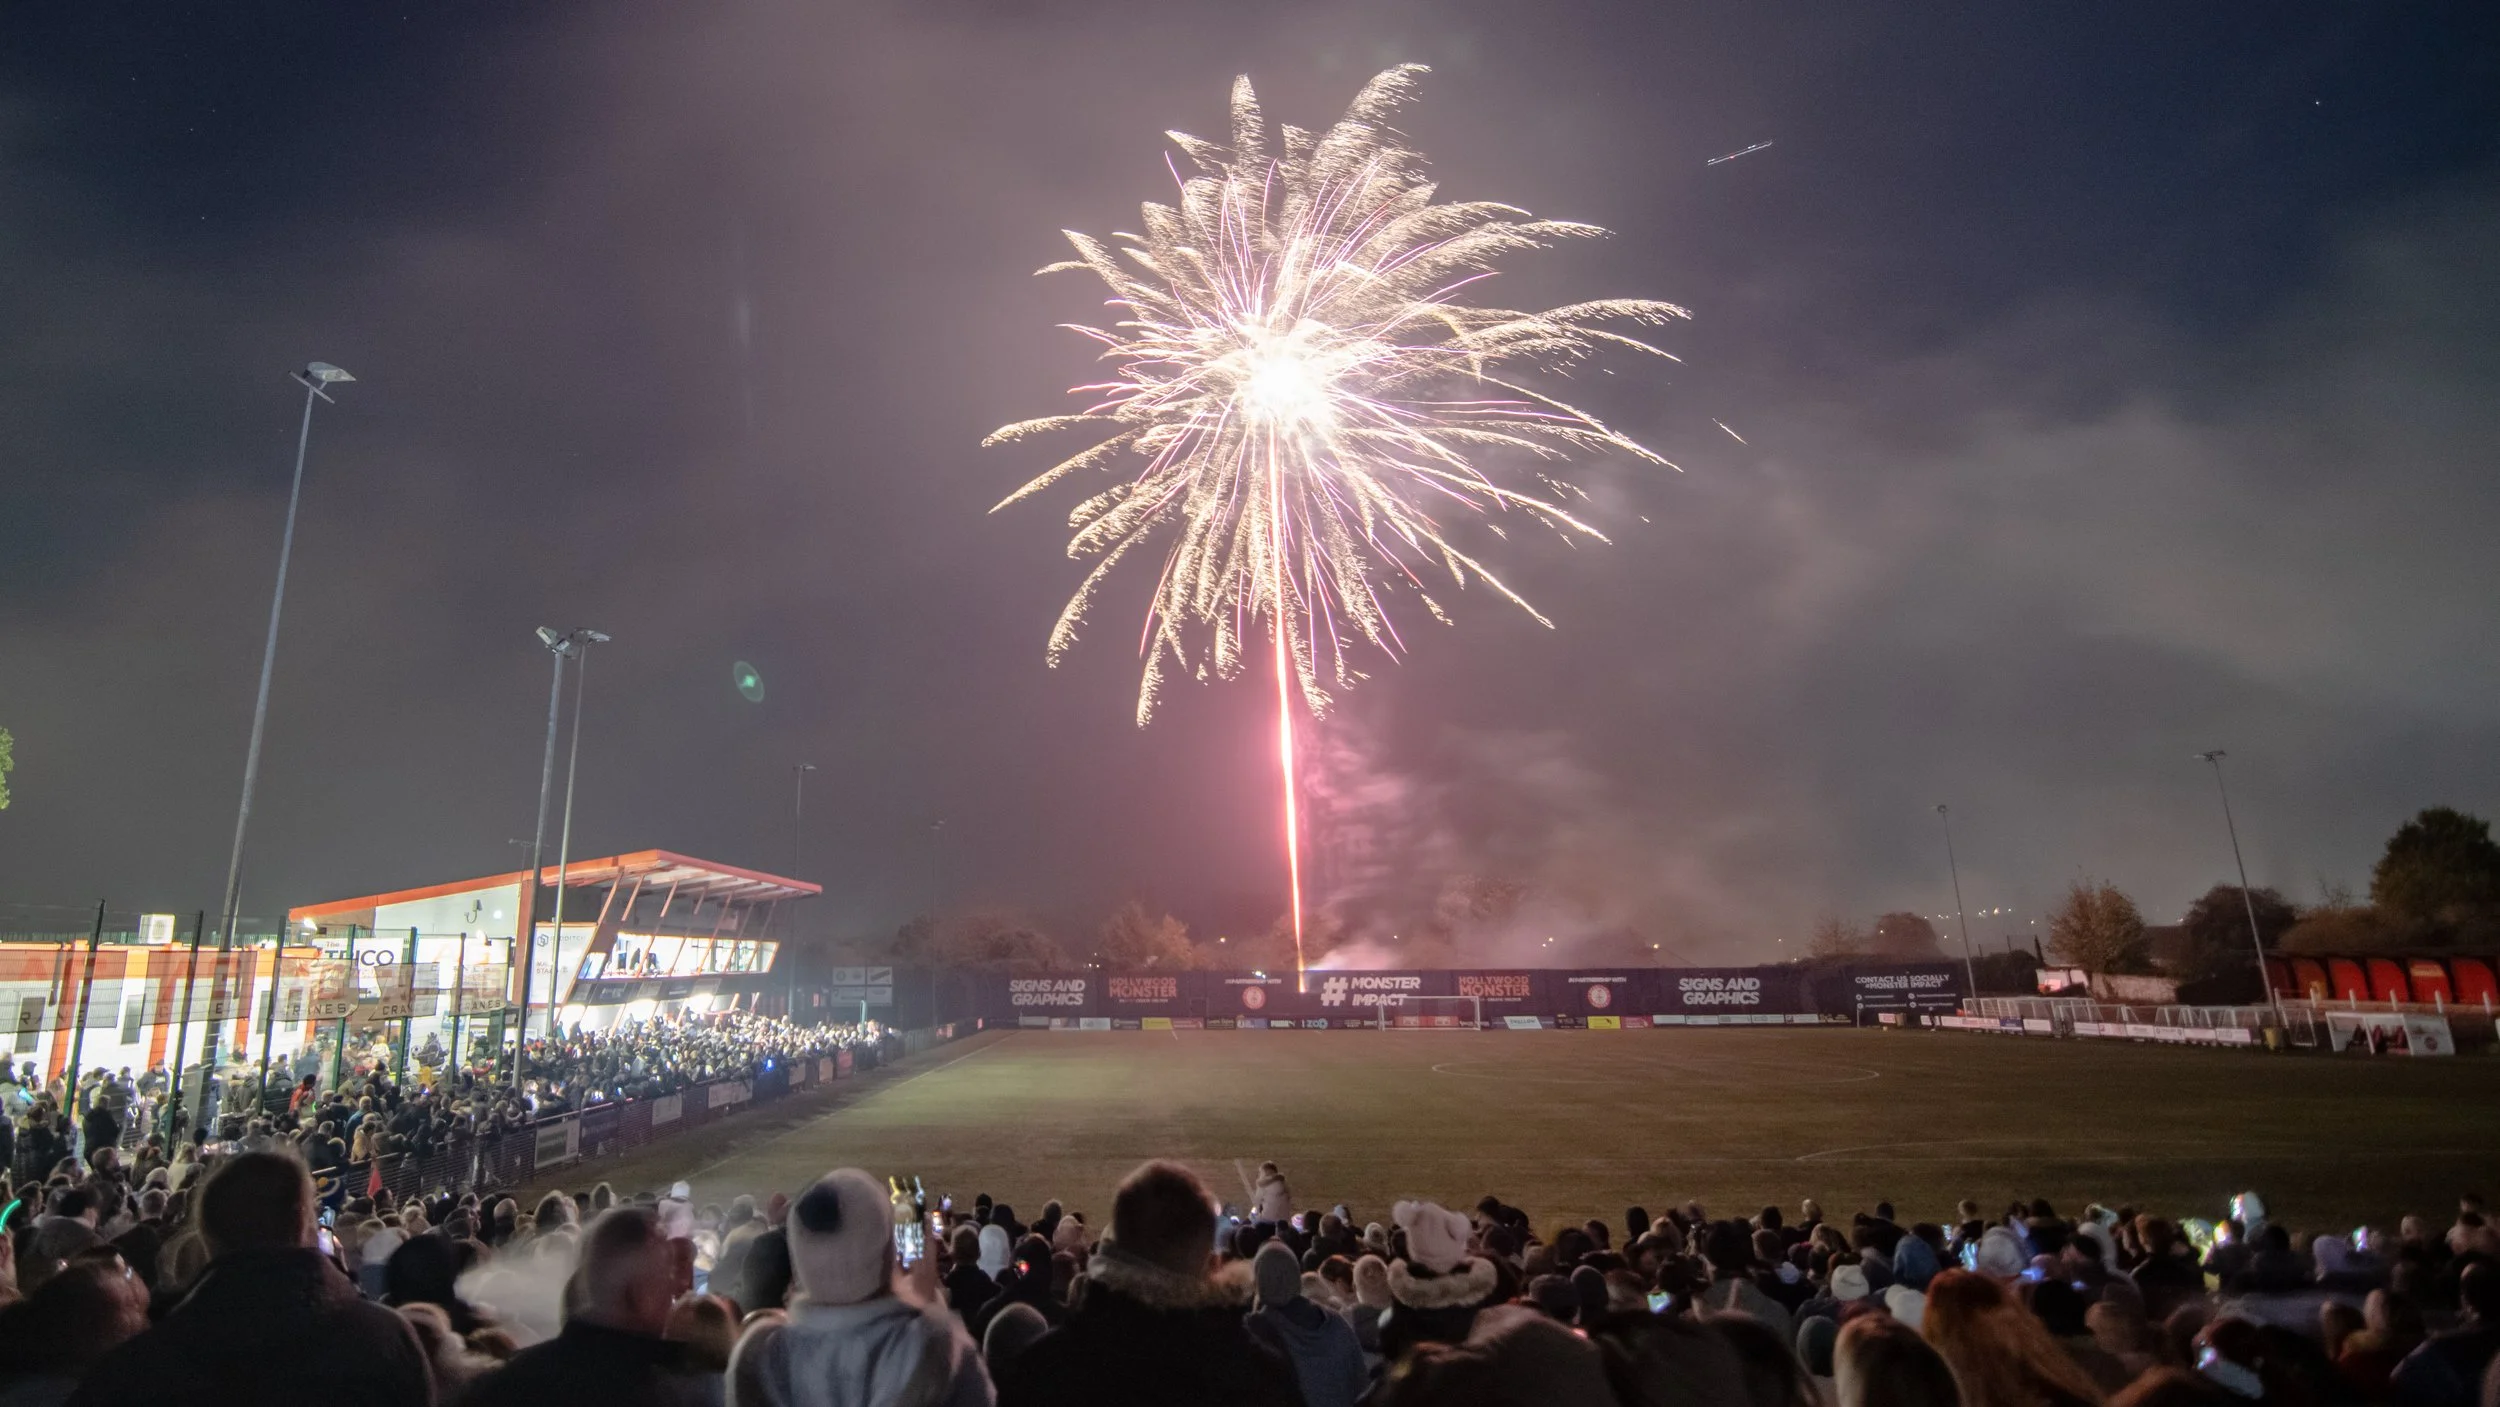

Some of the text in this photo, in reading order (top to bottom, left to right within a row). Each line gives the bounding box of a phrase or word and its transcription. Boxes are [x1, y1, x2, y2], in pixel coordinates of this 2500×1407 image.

[1009, 979, 1085, 992] SIGNS AND
[1109, 977, 1177, 986] HOLLYWOOD
[1350, 976, 1421, 989] MONSTER
[1459, 976, 1529, 985] HOLLYWOOD
[1678, 977, 1760, 991] SIGNS AND
[1855, 974, 1950, 984] CONTACT US SOCIALLY
[1109, 986, 1177, 998] MONSTER
[1459, 984, 1531, 997] MONSTER
[1012, 992, 1084, 1006] GRAPHICS
[1352, 993, 1408, 1006] IMPACT
[1683, 991, 1760, 1005] GRAPHICS
